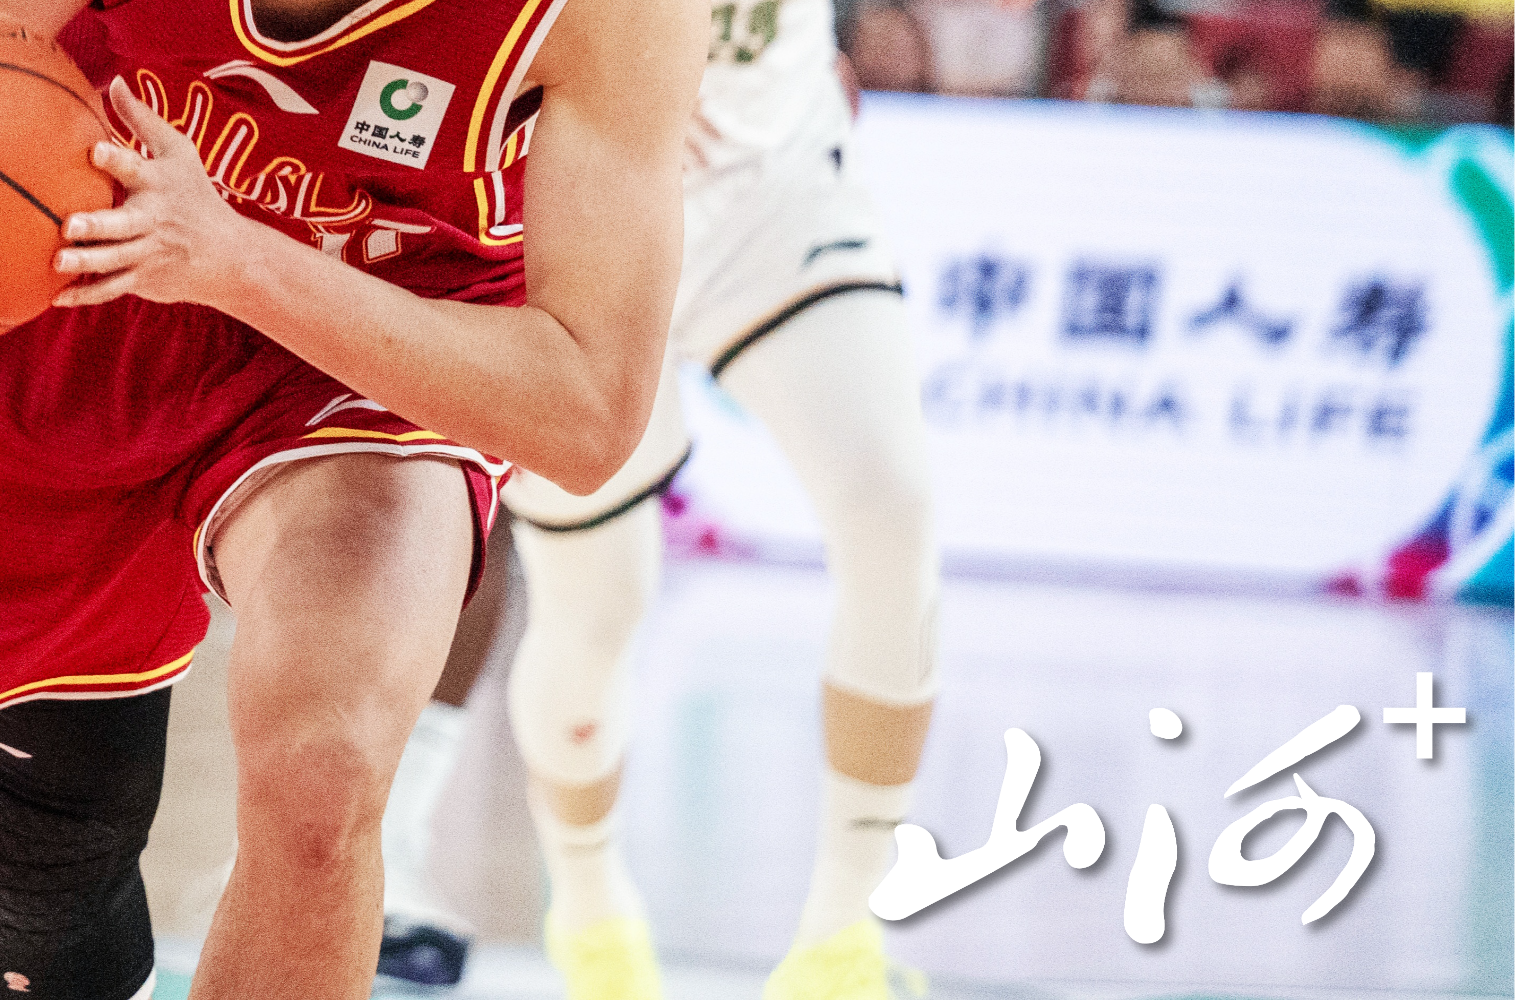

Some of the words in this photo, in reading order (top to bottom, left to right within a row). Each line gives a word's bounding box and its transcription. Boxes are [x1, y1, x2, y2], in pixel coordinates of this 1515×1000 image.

[349, 134, 390, 152] CHINA
[392, 145, 421, 159] LIFE
[354, 120, 427, 149] 中国人寿
[934, 241, 1432, 366] 中国人寿
[921, 357, 1188, 437] CHINA
[1226, 383, 1416, 446] LIFE
